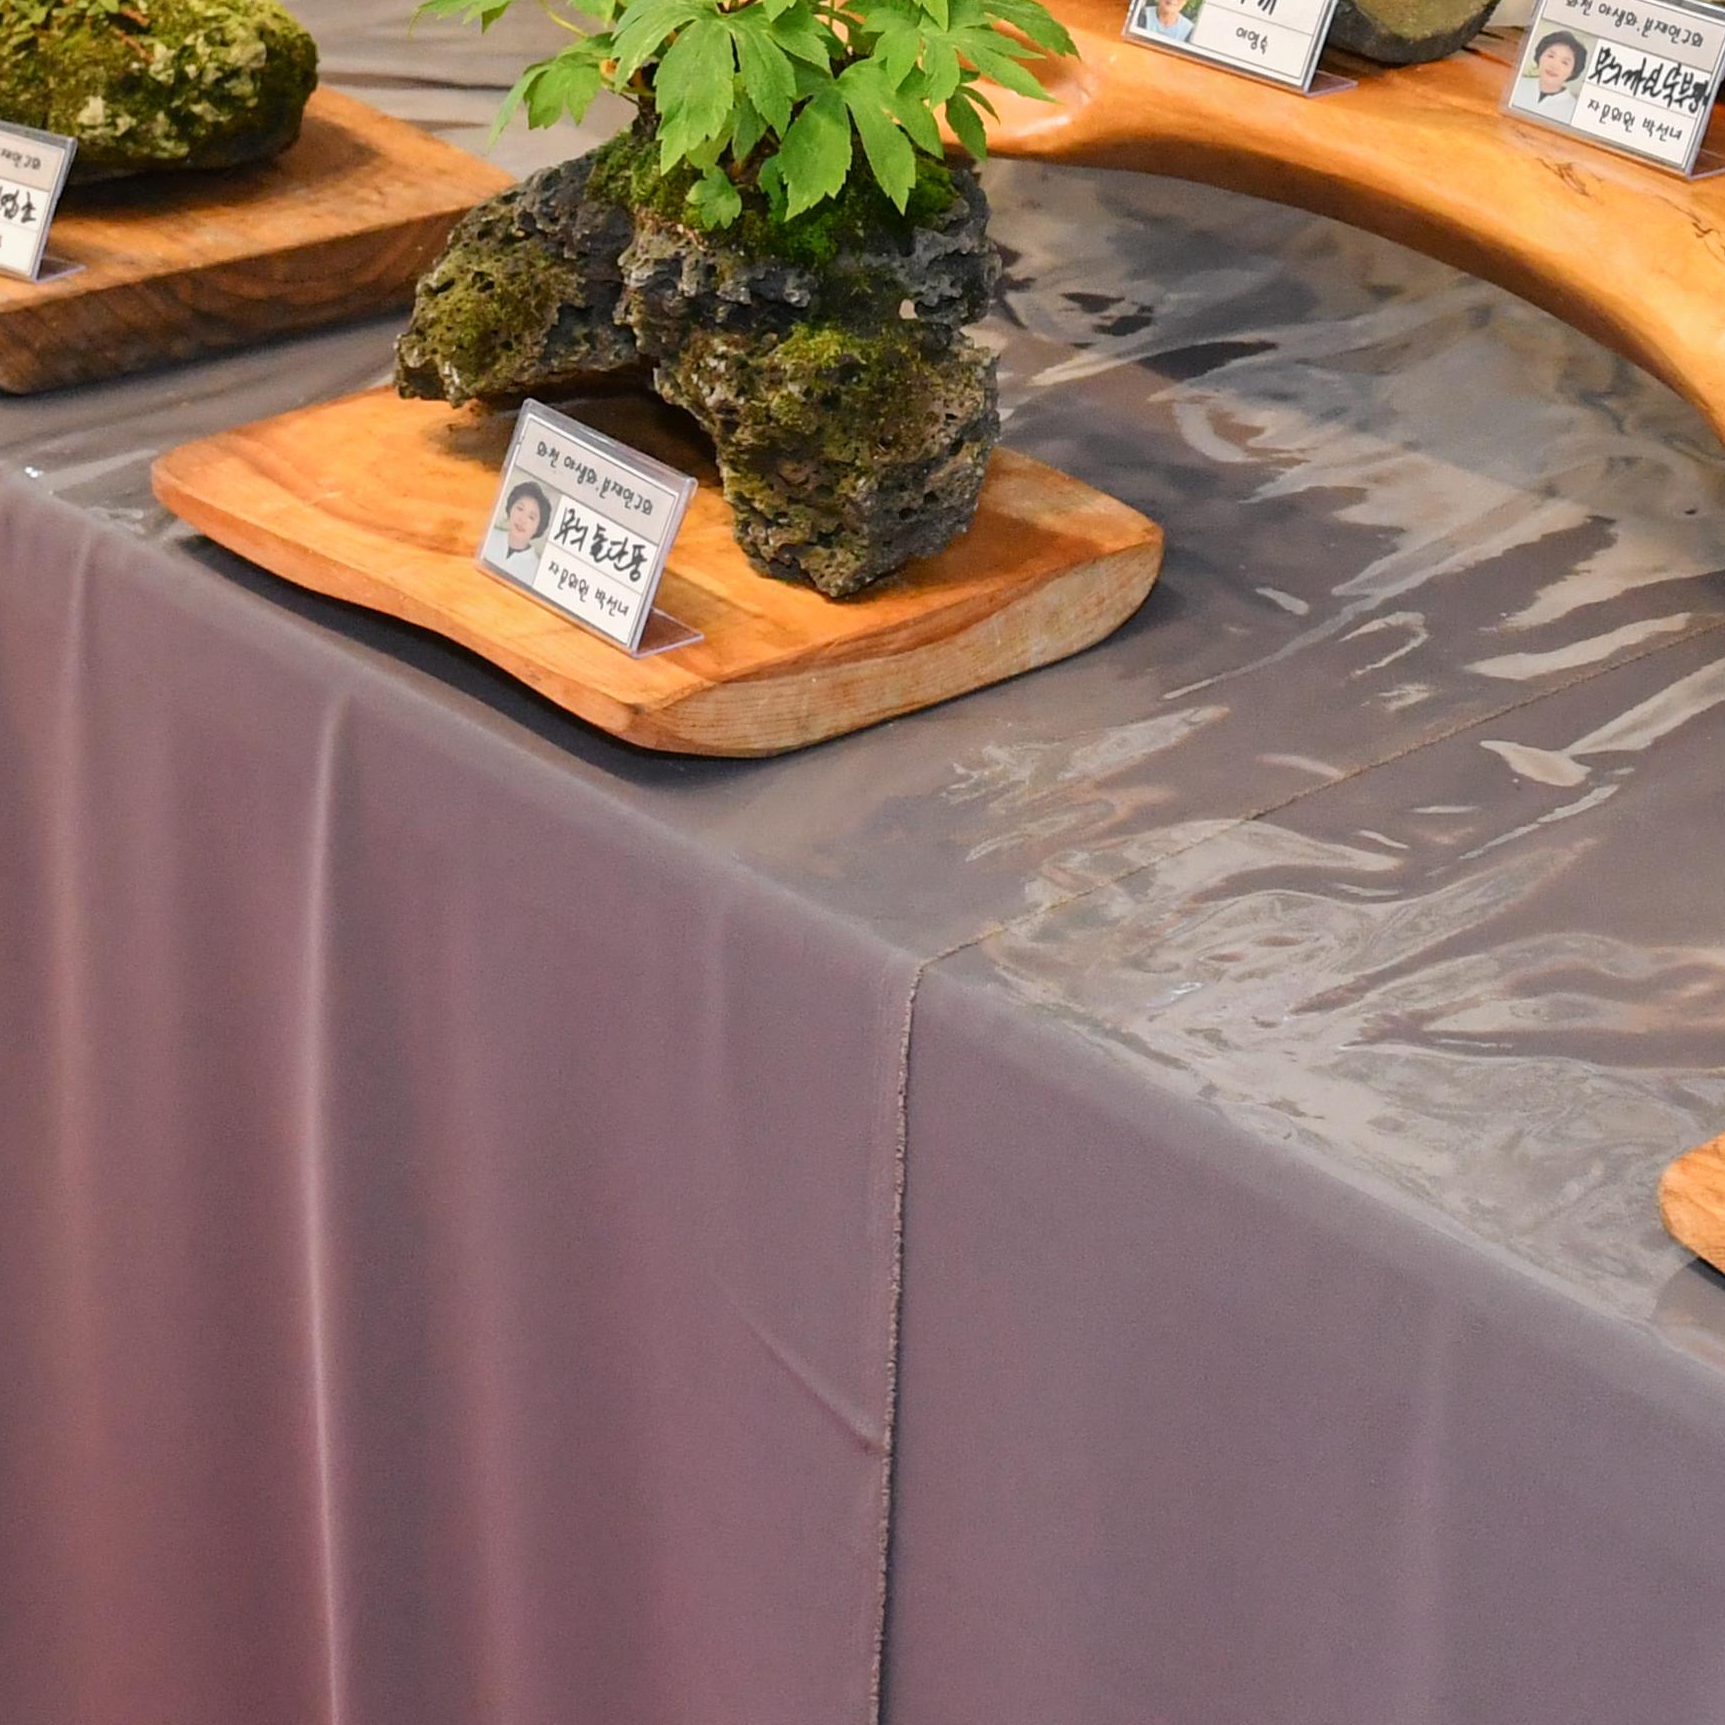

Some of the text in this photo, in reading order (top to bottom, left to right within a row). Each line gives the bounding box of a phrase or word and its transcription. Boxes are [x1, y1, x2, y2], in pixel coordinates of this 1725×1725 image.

[1587, 98, 1636, 132] 자문위원
[536, 441, 561, 469] 화천
[548, 561, 591, 602] 자문위원
